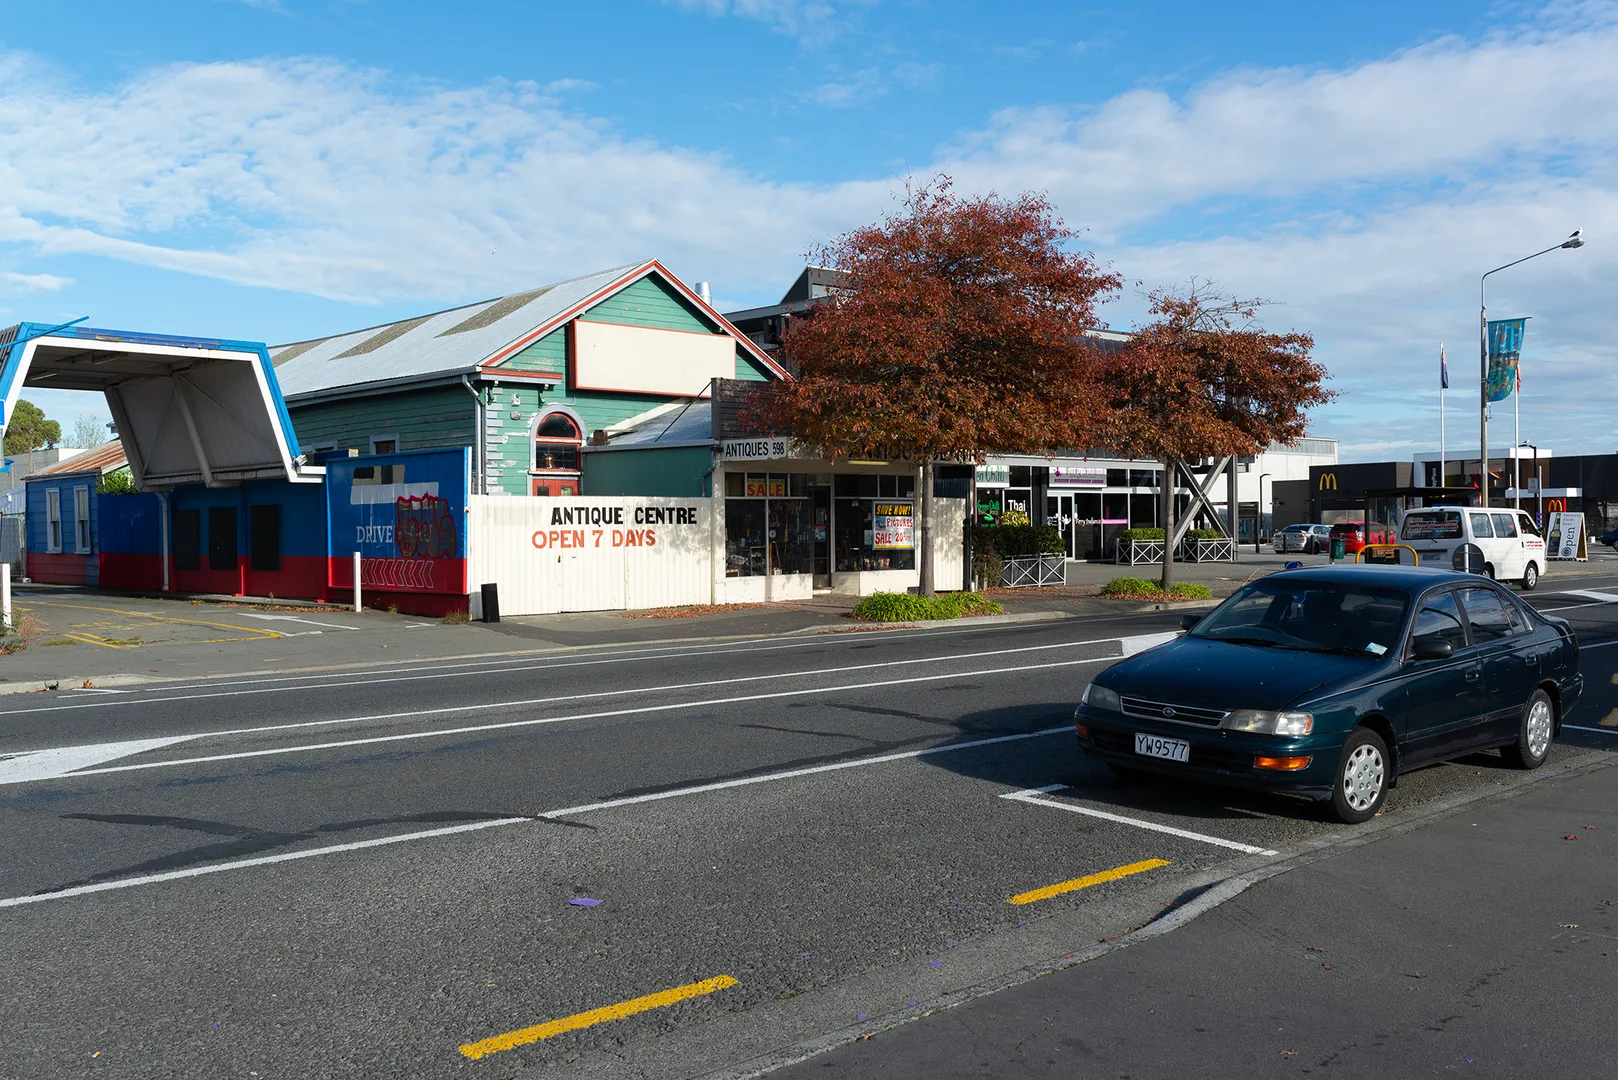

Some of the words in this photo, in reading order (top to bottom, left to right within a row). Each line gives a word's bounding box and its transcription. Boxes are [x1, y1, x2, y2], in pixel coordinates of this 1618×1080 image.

[725, 441, 769, 457] ANTIQUES
[772, 441, 785, 455] 598
[746, 483, 784, 497] SALE
[876, 504, 893, 515] SAVE
[893, 504, 912, 515] NOW!
[1008, 499, 1026, 512] Thai
[551, 507, 624, 527] ANTIQUE
[635, 507, 698, 525] CENTRE
[886, 517, 913, 528] PICTURES
[356, 525, 393, 543] DRIVE
[532, 529, 585, 549] OPEN
[592, 529, 604, 548] 7
[612, 529, 656, 548] DAYS
[875, 532, 892, 545] SALE
[1137, 735, 1188, 760] YW9577
